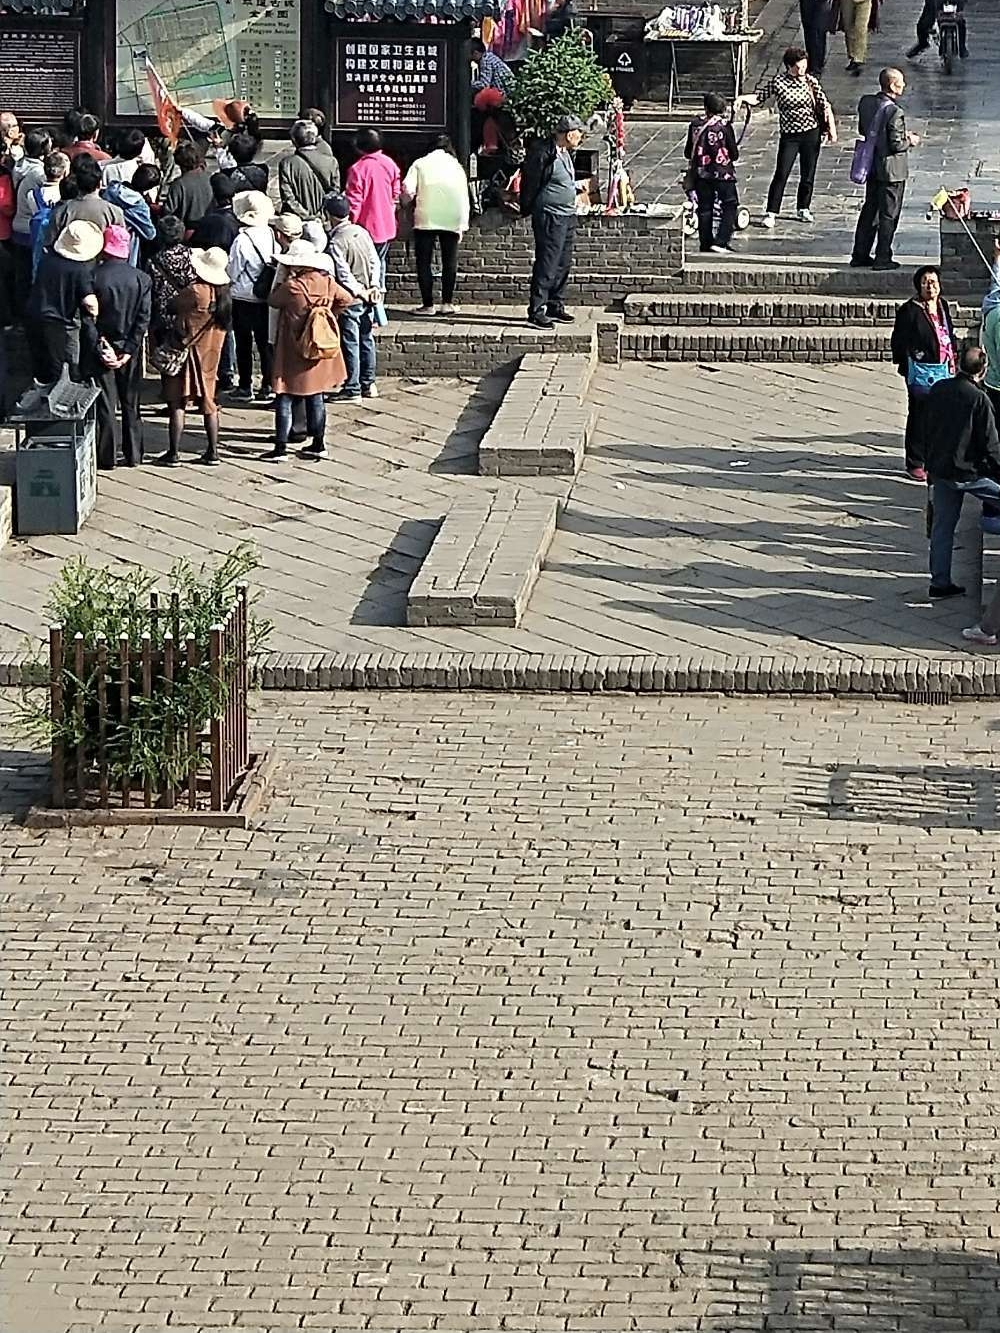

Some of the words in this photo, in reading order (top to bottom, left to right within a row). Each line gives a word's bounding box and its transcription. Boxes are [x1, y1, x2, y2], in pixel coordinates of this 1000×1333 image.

[345, 43, 438, 56] 创建国家卫生县城
[345, 58, 438, 71] 构建文明和谐社会
